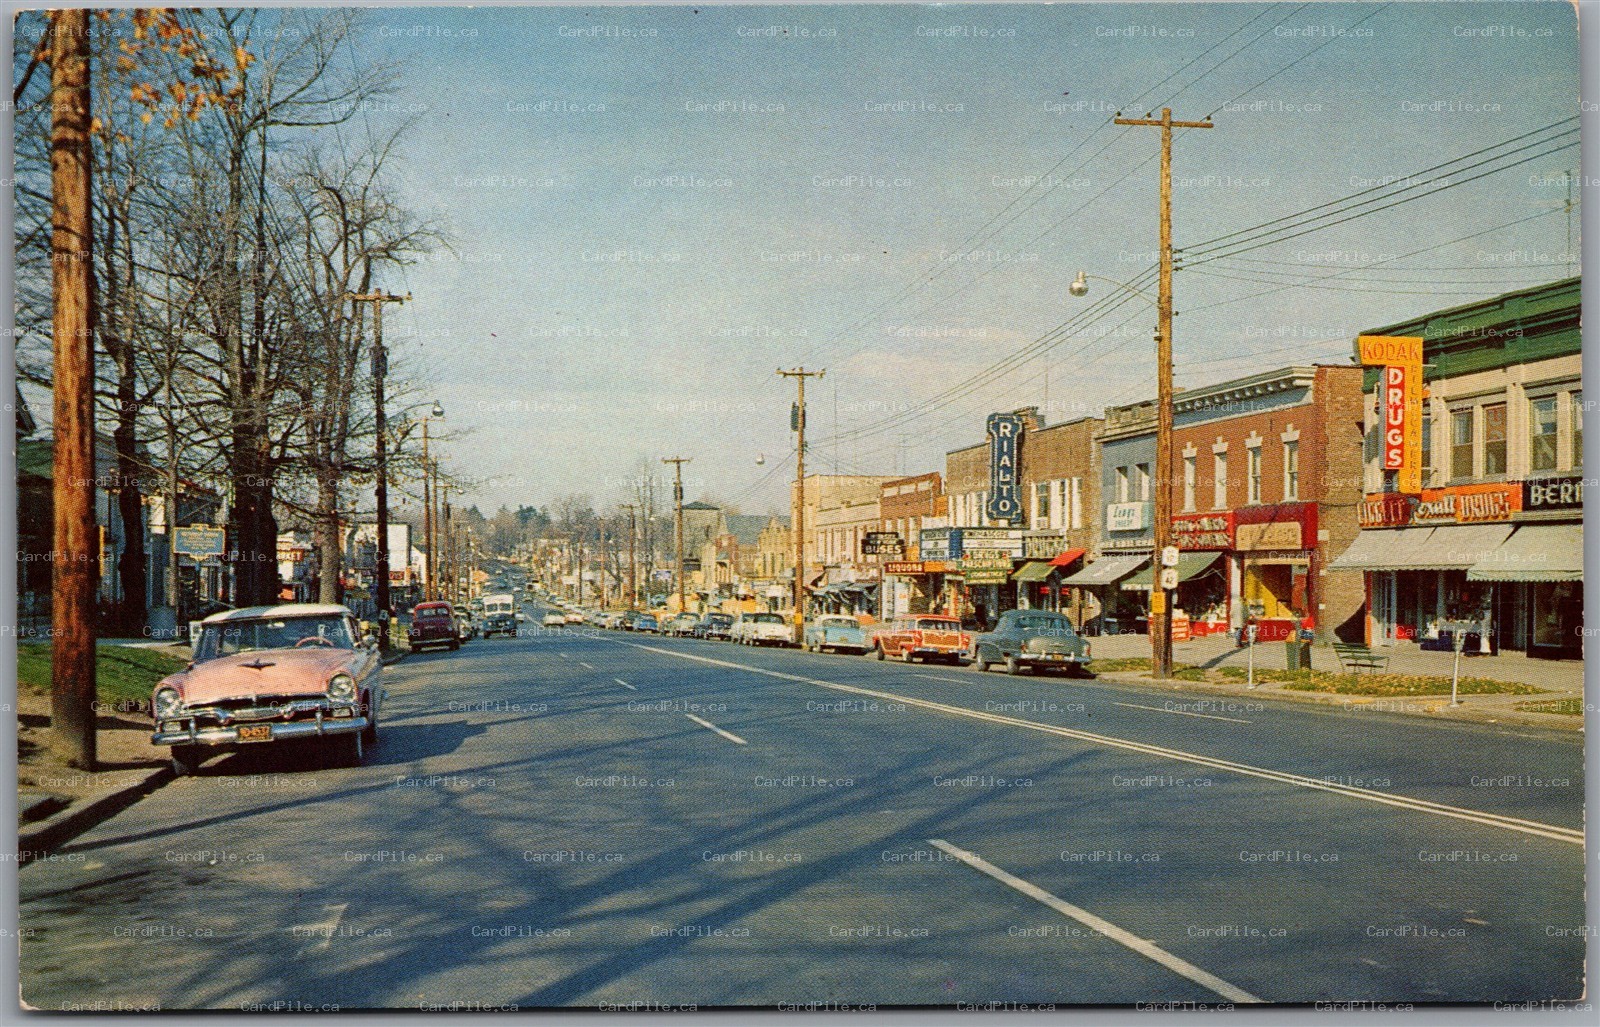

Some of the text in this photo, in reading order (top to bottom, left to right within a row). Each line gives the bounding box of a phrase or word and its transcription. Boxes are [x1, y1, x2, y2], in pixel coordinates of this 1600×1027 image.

[1362, 340, 1421, 361] KODAK
[1387, 368, 1403, 467] DRUGS
[999, 422, 1012, 512] RIALTO
[1459, 492, 1510, 521] DRUGS
[865, 544, 902, 555] BUSES
[888, 563, 923, 573] LIQUORS
